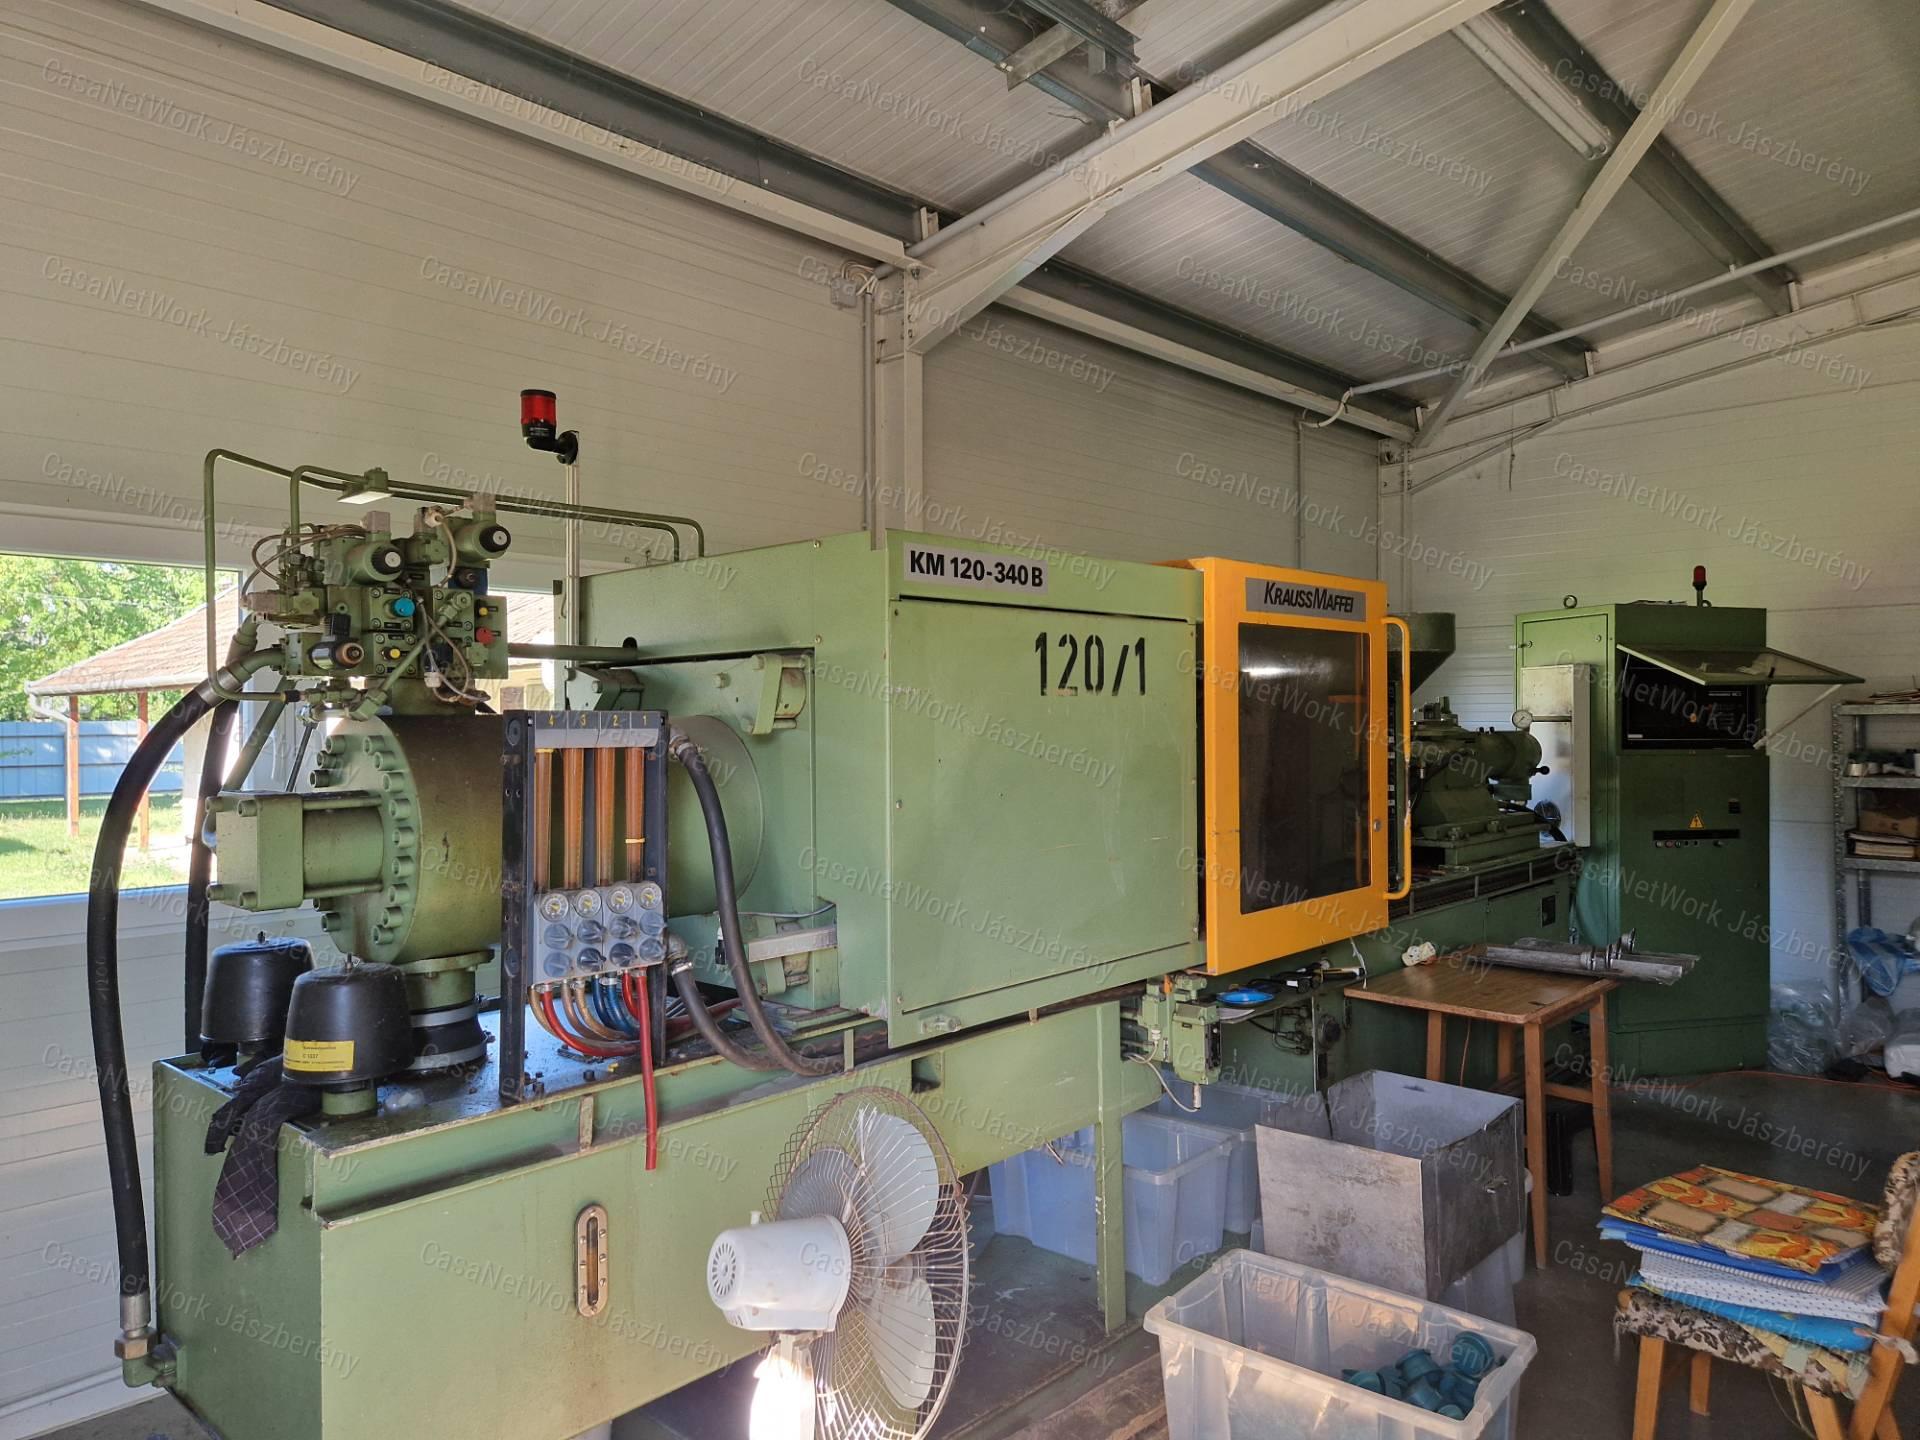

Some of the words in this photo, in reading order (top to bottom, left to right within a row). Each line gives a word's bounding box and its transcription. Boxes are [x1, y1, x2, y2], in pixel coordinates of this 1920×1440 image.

[910, 550, 945, 576] KM
[1034, 632, 1146, 697] 120/1
[580, 714, 587, 727] 3
[612, 714, 619, 727] 2
[642, 714, 647, 727] 1
